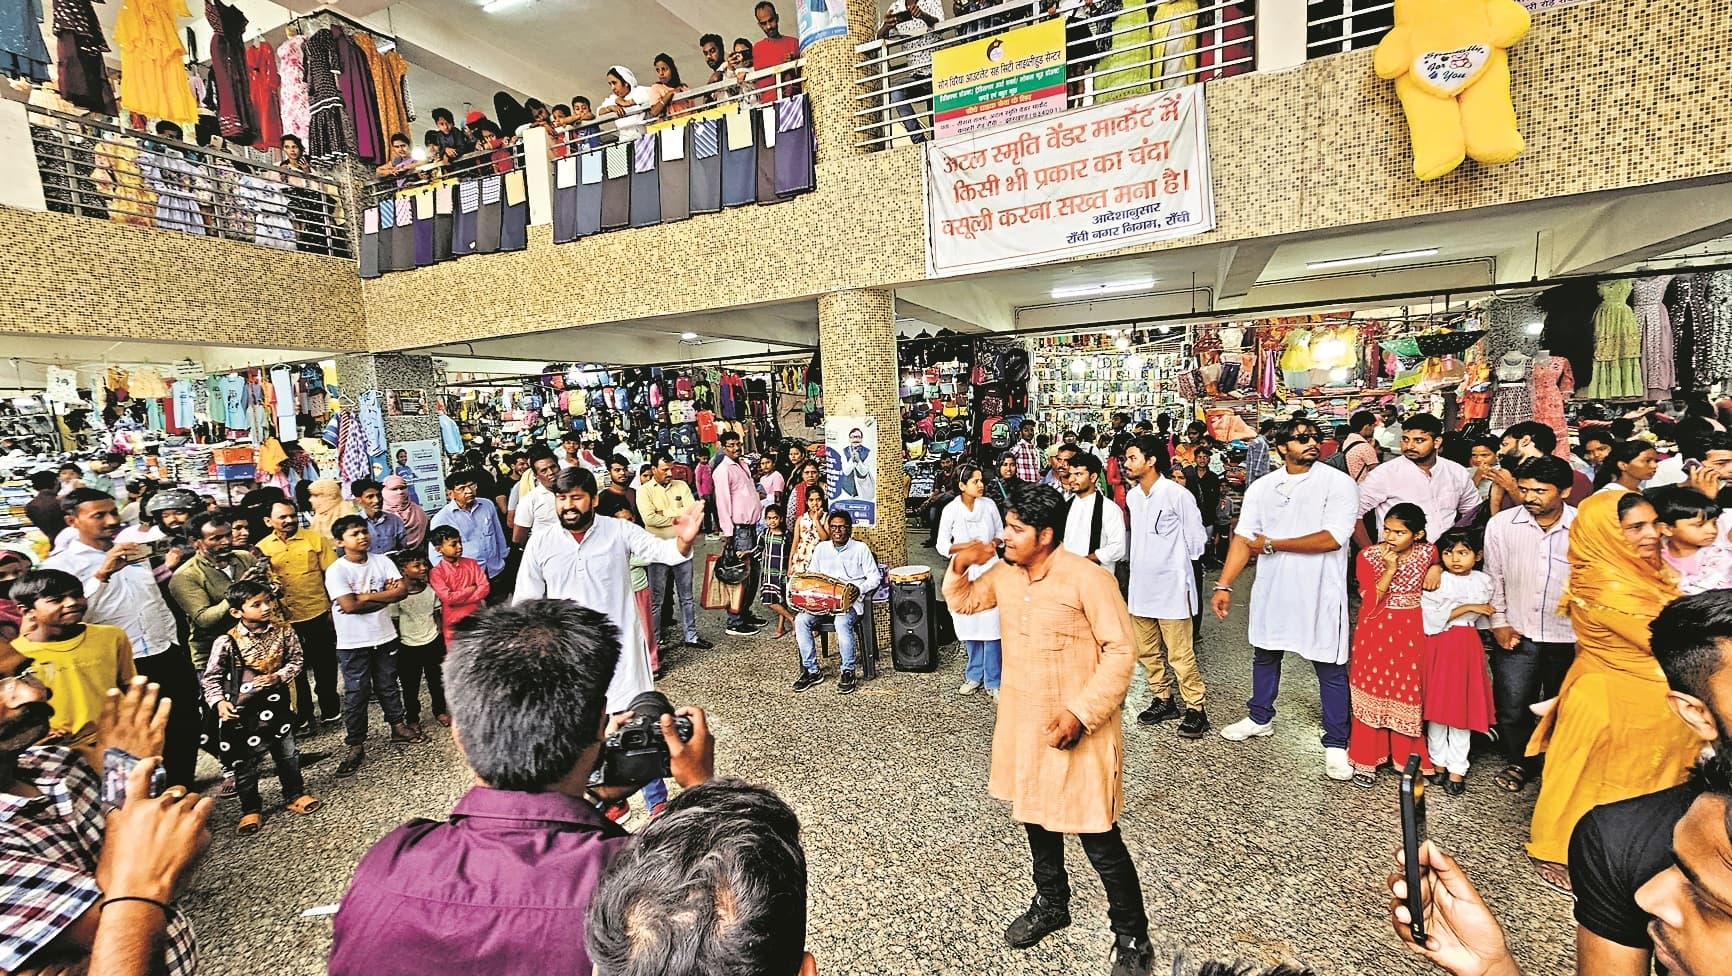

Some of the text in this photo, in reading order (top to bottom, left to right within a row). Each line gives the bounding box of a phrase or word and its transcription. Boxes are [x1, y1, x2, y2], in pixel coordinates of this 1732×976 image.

[965, 68, 989, 83] आउटलेट
[990, 66, 1000, 76] सह
[1000, 60, 1014, 74] सिटी
[1443, 71, 1466, 82] You
[944, 93, 1182, 174] अटल स्मृति वेंडर मार्केट में
[953, 137, 1169, 203] किसी भी प्रकार का चंदा
[941, 168, 1189, 240] वसूली करना सख्त मना है।
[1092, 202, 1161, 225] आदेशानुसार
[1066, 211, 1191, 245] राँची नगर निगम, राँची
